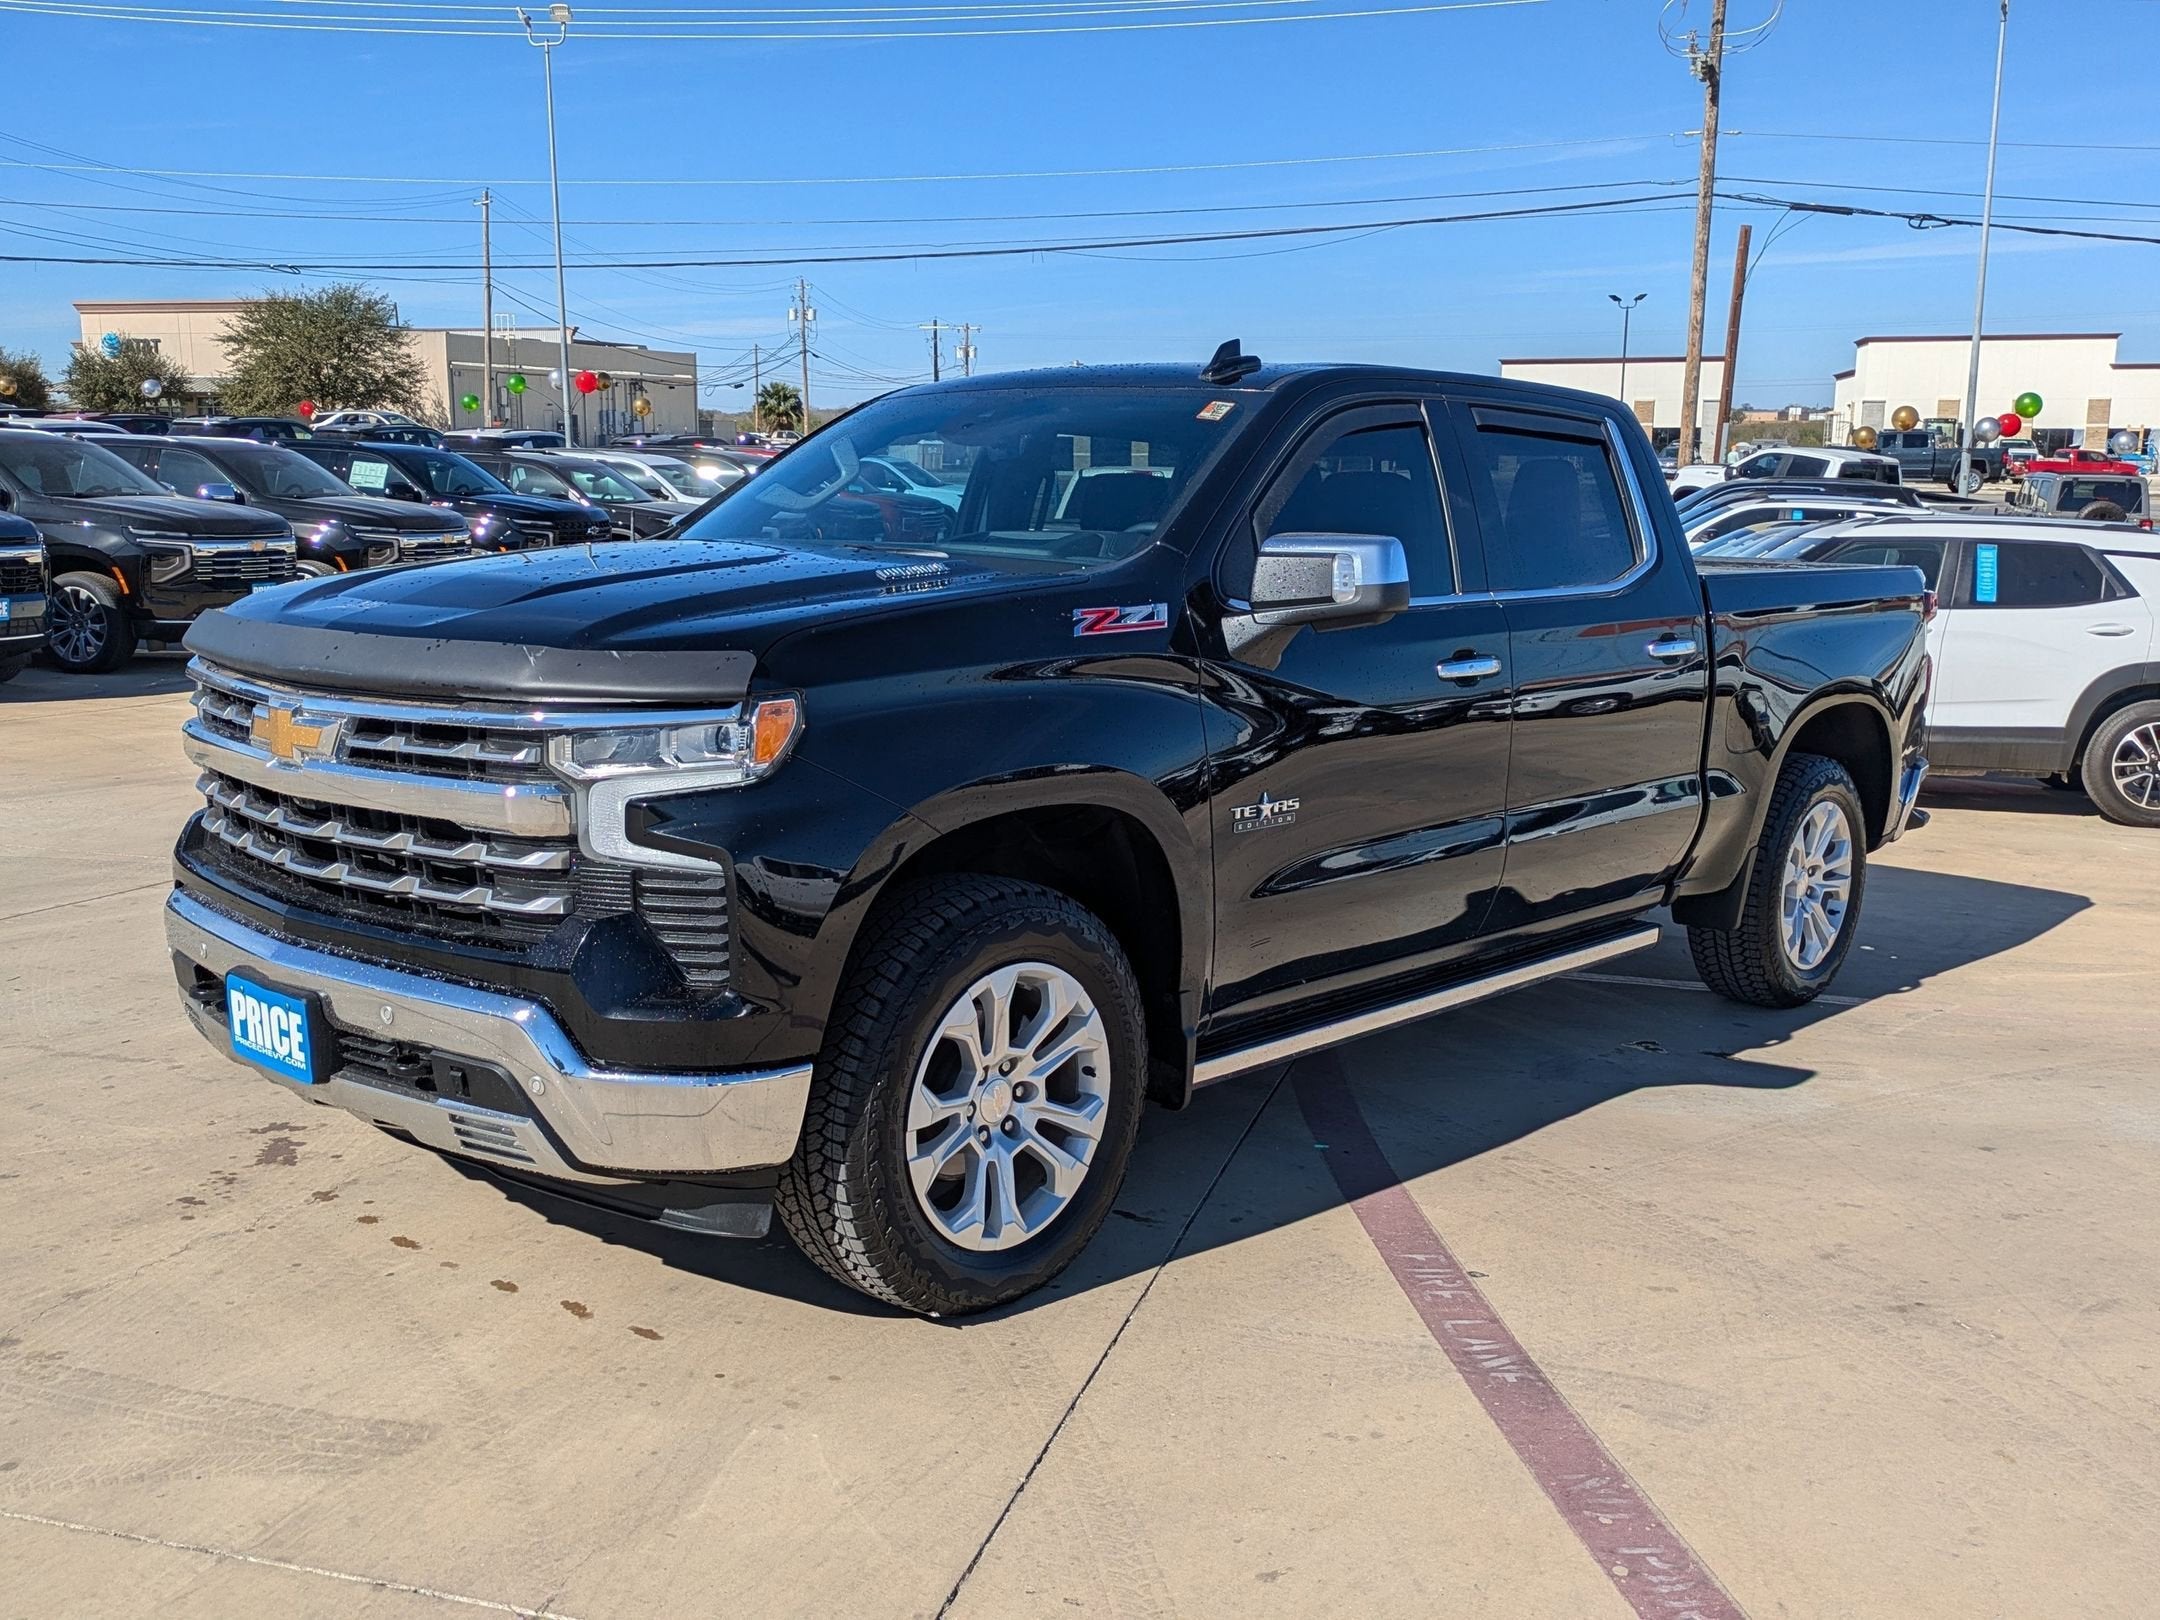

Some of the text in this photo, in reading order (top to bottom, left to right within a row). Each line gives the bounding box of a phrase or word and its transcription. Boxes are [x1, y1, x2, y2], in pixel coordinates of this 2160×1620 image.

[1072, 603, 1168, 637] Z71
[1230, 794, 1300, 821] TEXAS
[1238, 815, 1292, 829] EDITION
[230, 989, 306, 1062] PRICE
[235, 1035, 306, 1070] PRICECHEVY.COM
